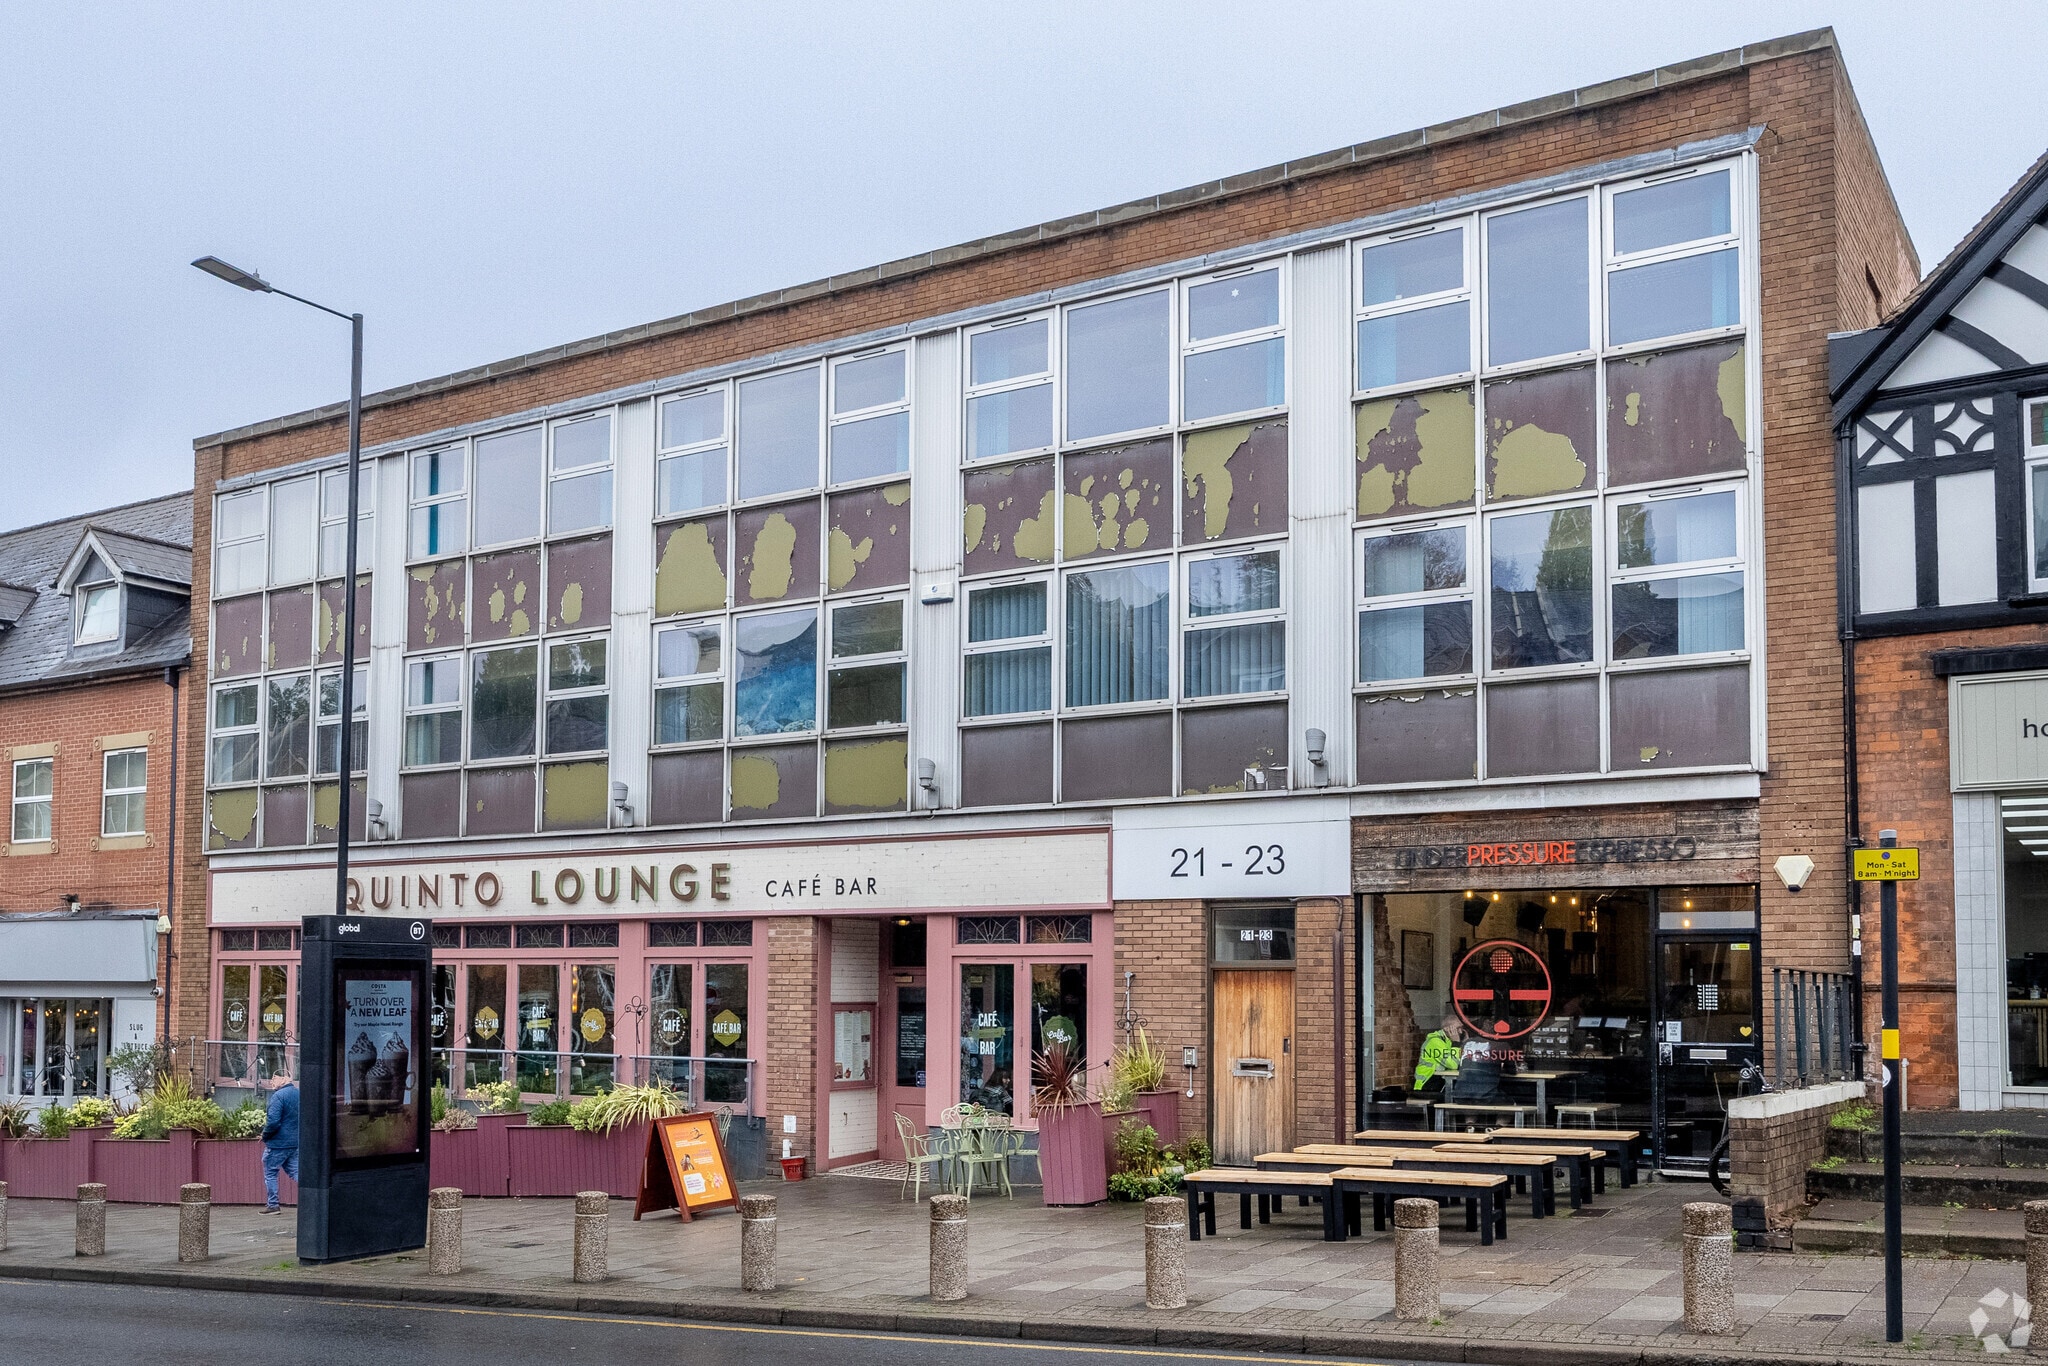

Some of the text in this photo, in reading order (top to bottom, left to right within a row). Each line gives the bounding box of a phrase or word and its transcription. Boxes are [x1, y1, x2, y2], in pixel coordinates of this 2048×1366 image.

[1467, 841, 1576, 865] PRESSURE
[1170, 847, 1204, 877] 21
[1245, 844, 1285, 876] 23
[346, 863, 877, 912] QUINTO LOUNGE CAFÉ BAR
[339, 924, 360, 934] global
[354, 997, 405, 1006] TURN OVER
[230, 1009, 243, 1021] CAFÉ
[263, 1012, 283, 1022] CAFÉ BAR
[350, 1008, 407, 1016] A NEW LEAF
[532, 1004, 546, 1018] CAFÉ
[663, 1017, 680, 1032] CAFÉ
[978, 1010, 997, 1027] CAFÉ
[129, 1023, 143, 1031] SLUG
[712, 1021, 741, 1034] CAFÉ BAR
[532, 1029, 545, 1041] BAR
[980, 1041, 995, 1055] BAR
[1423, 1048, 1457, 1059] NDER
